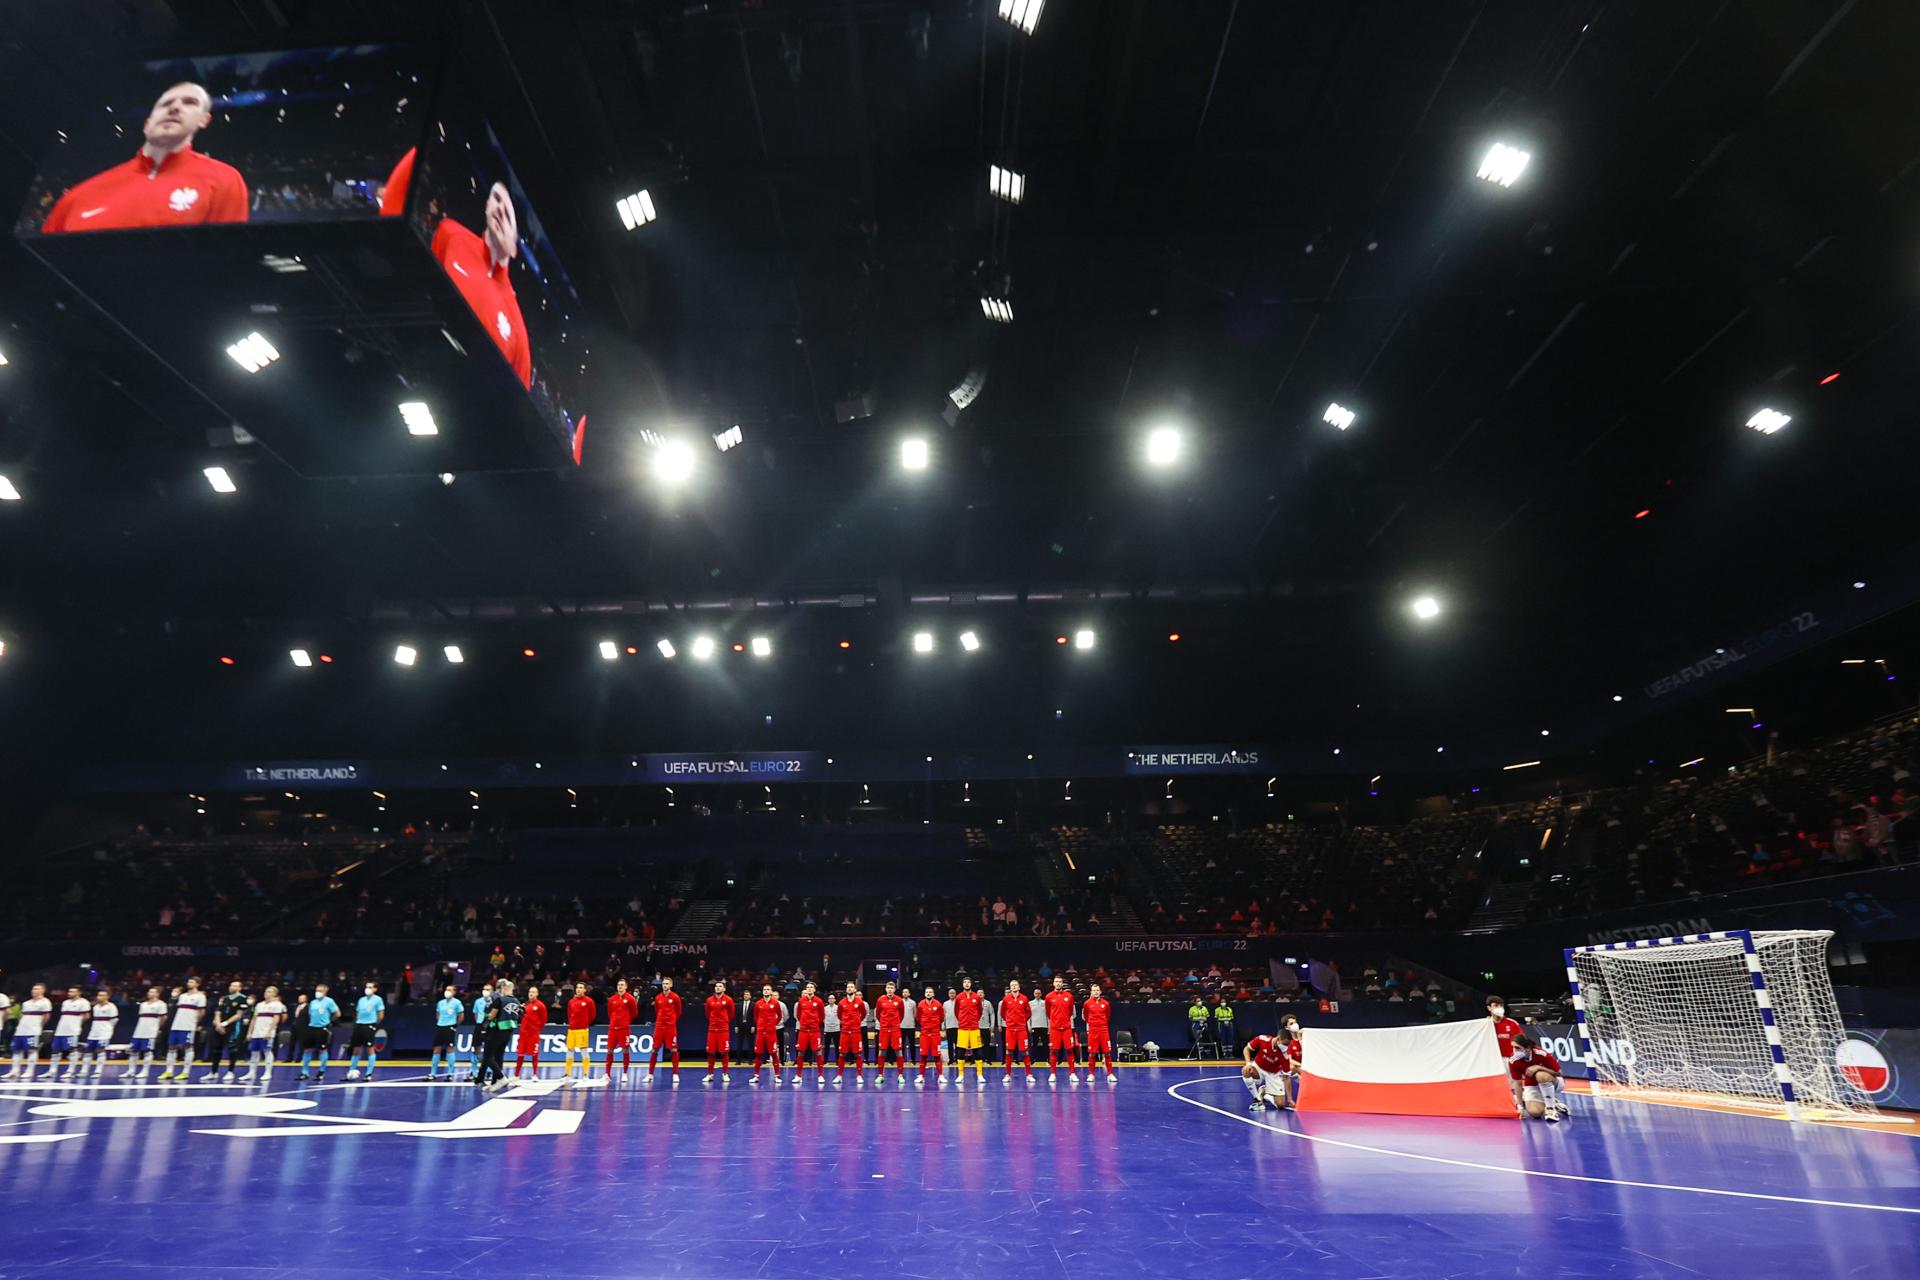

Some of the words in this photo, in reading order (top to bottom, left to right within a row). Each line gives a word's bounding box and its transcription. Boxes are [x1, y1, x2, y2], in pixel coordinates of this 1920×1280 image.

[1161, 752, 1259, 765] NETHERLANDS
[244, 768, 269, 780] TE
[626, 944, 708, 955] AMERAM
[595, 1034, 654, 1054] ERO
